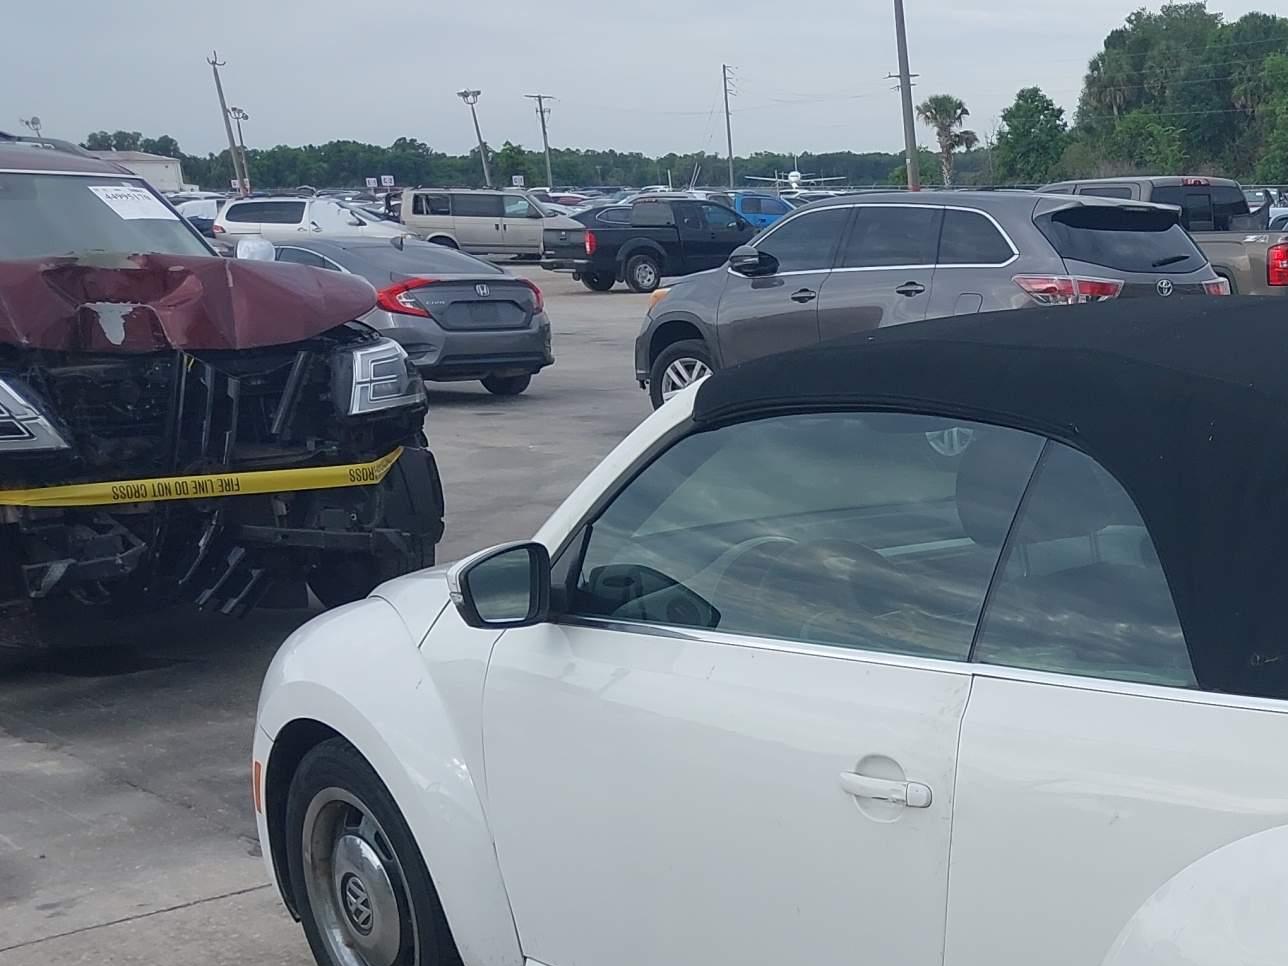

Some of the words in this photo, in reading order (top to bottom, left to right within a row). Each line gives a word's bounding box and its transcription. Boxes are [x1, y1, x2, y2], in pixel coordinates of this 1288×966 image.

[111, 483, 147, 500] CROSS
[152, 482, 172, 497] NOT
[175, 480, 189, 496] DO
[192, 479, 214, 495] LINE
[218, 477, 240, 492] FIRE
